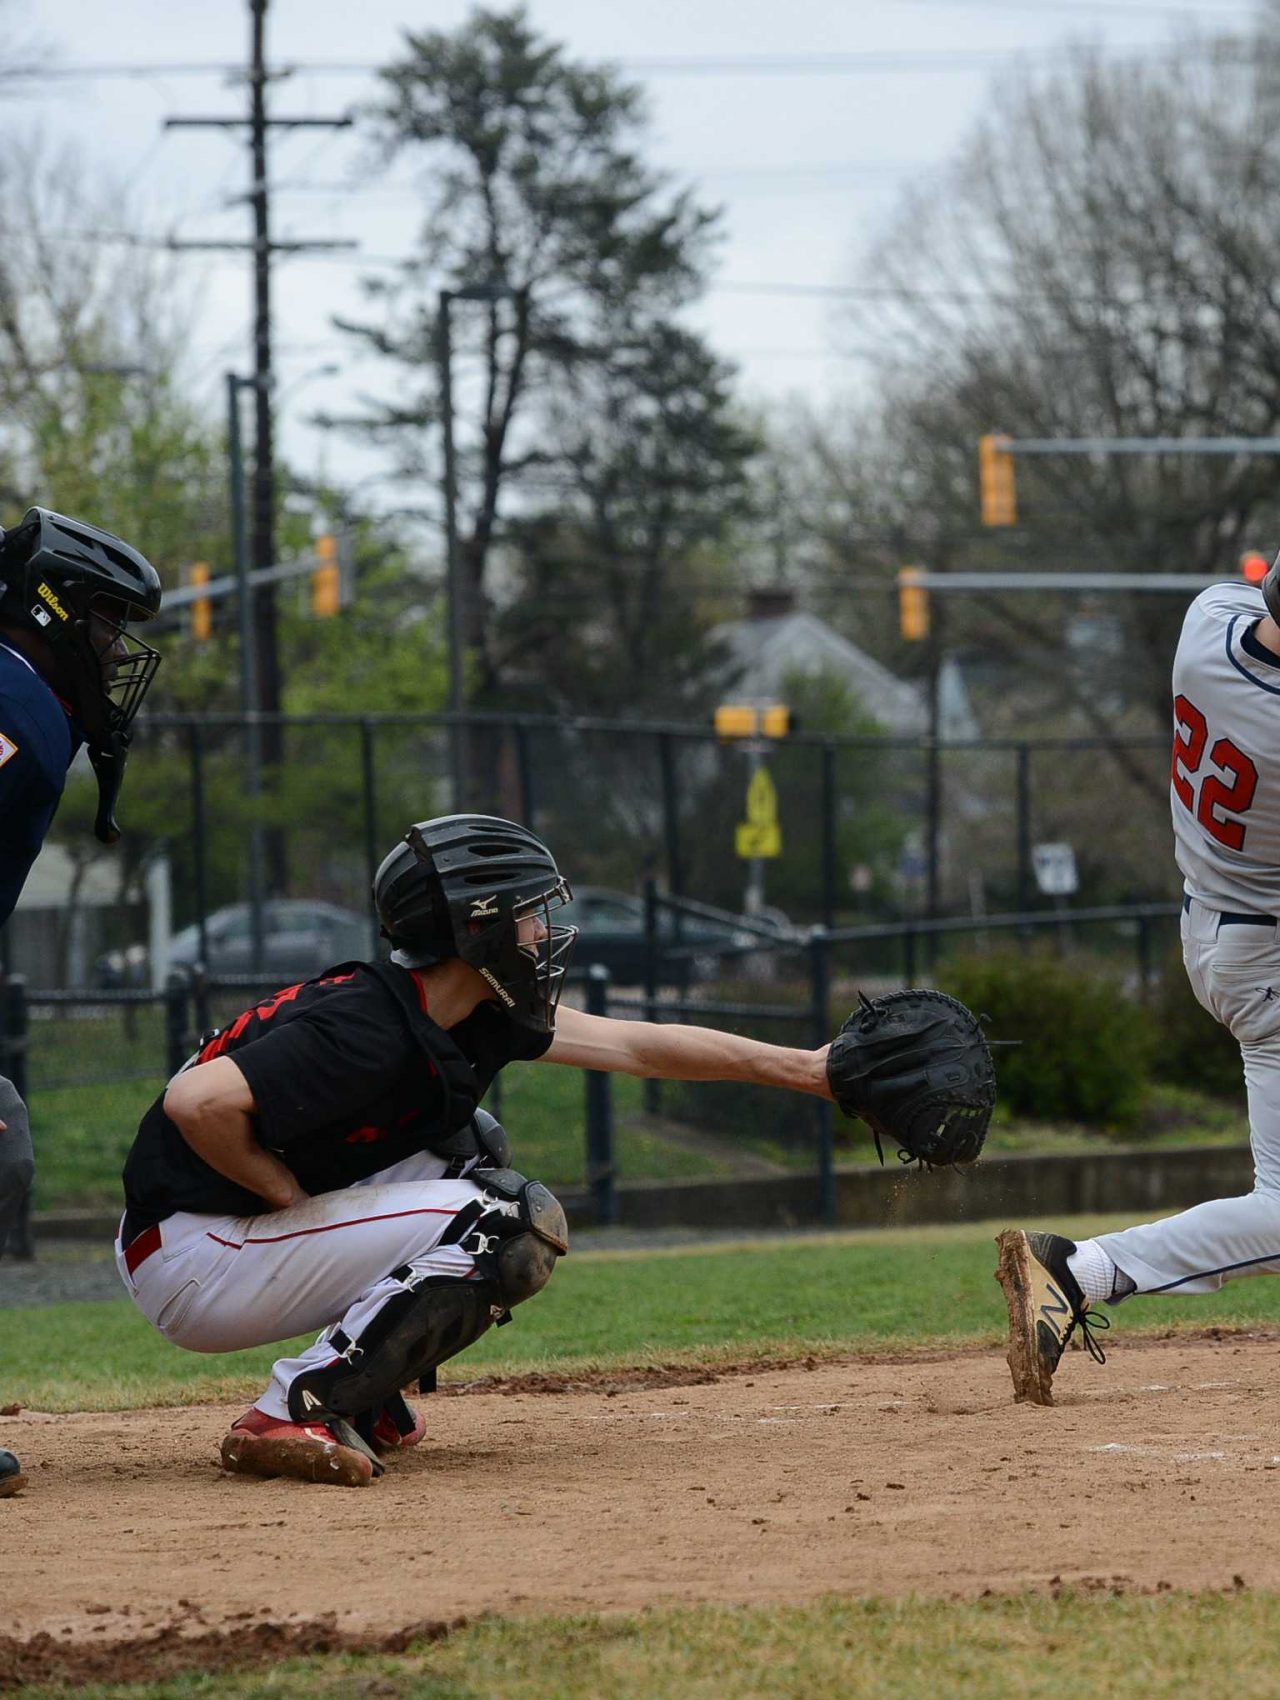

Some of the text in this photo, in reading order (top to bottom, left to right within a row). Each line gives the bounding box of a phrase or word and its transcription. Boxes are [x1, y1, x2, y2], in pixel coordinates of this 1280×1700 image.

[38, 582, 69, 621] Wilson
[1171, 694, 1259, 852] 22
[479, 967, 516, 1008] SAMURAI
